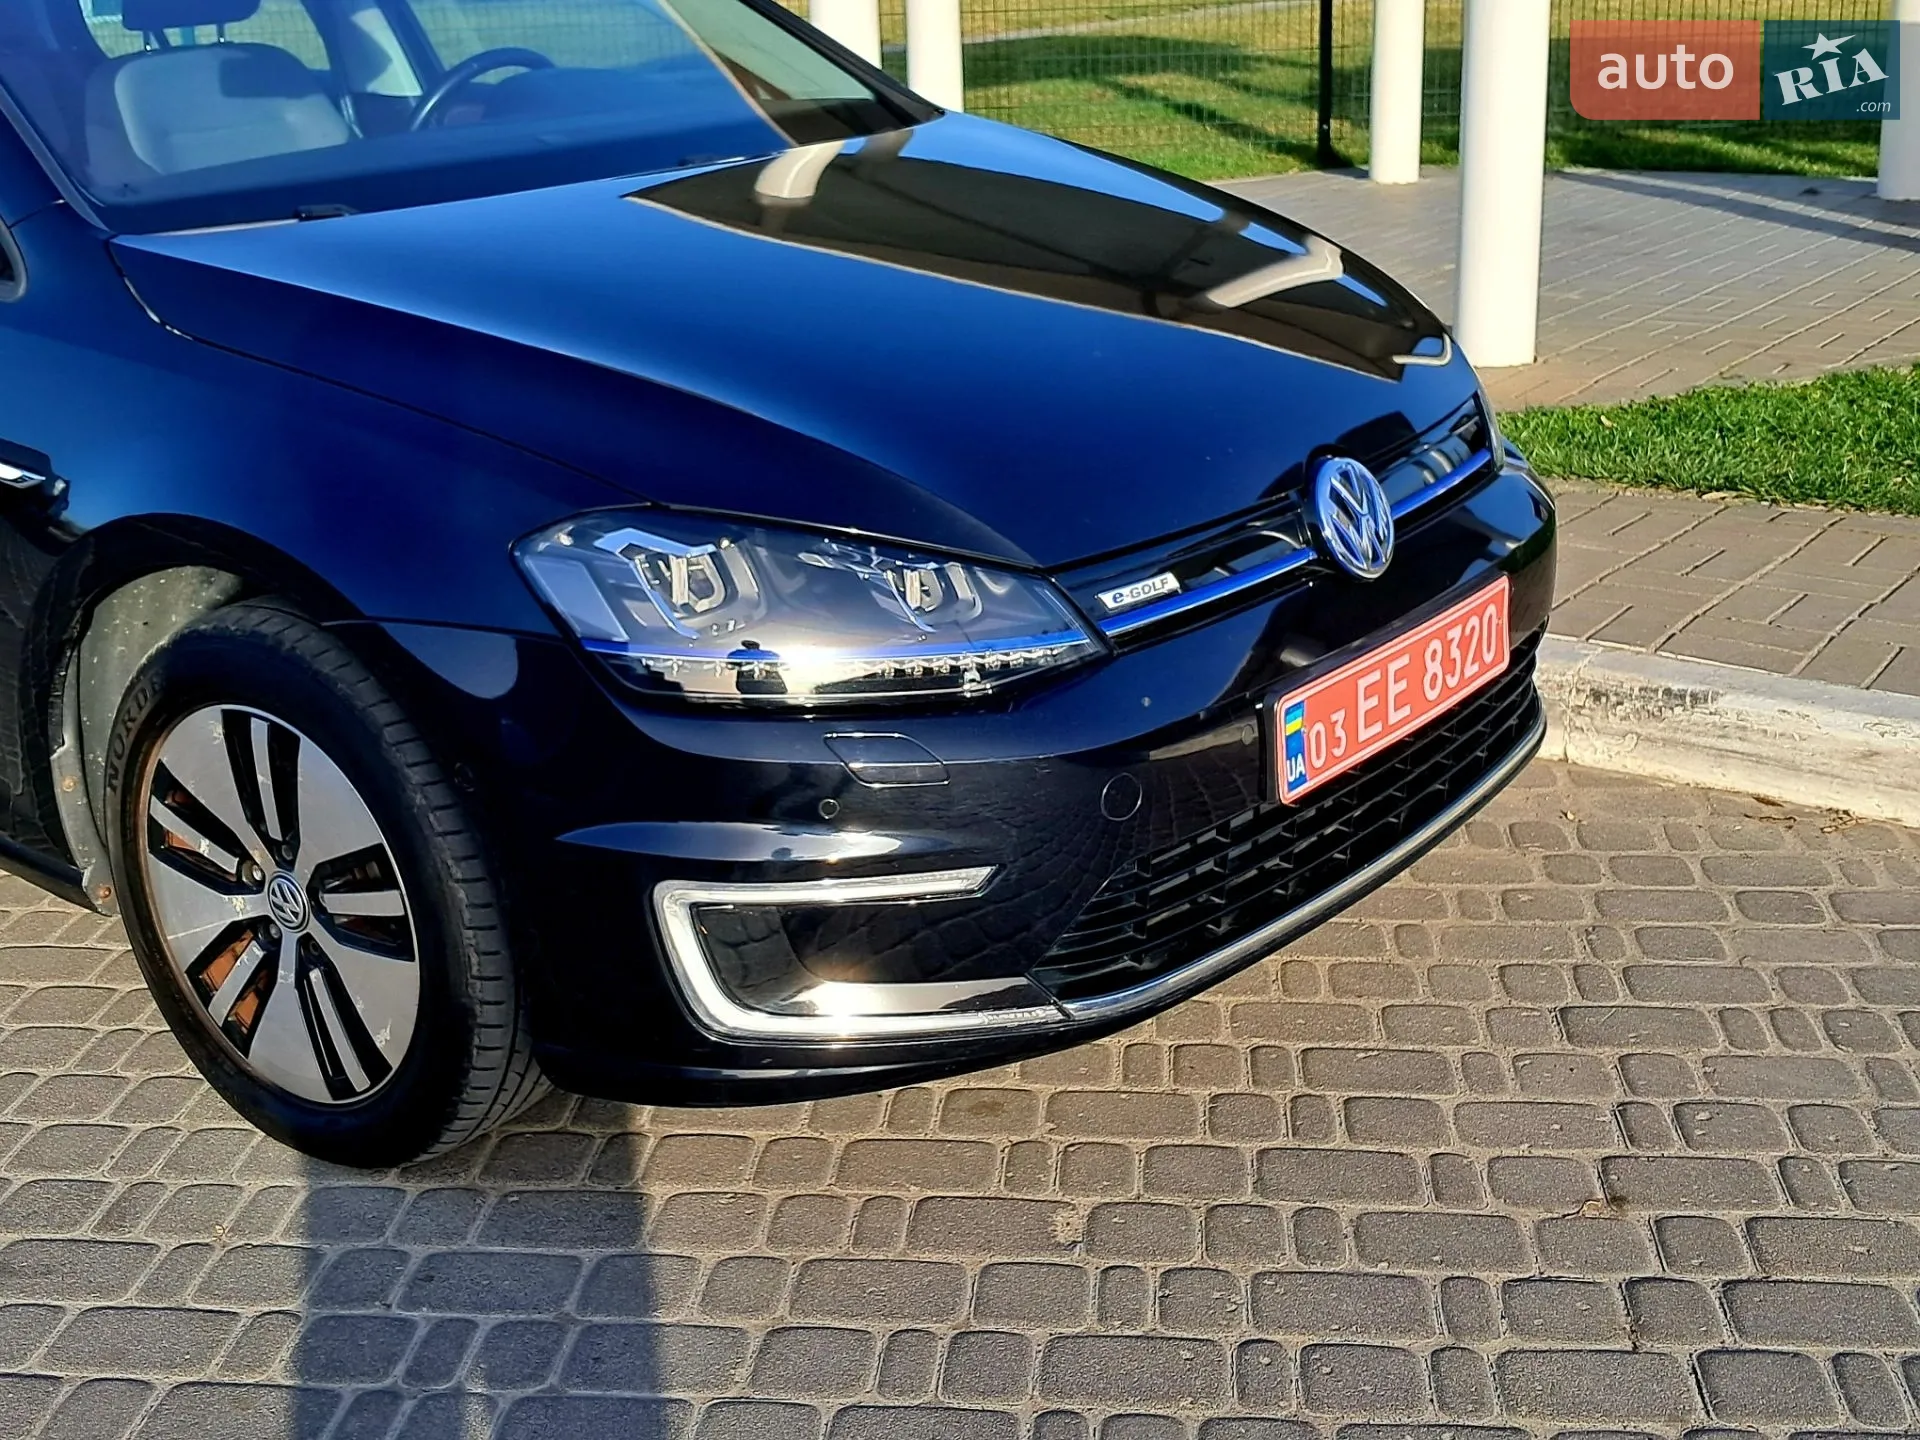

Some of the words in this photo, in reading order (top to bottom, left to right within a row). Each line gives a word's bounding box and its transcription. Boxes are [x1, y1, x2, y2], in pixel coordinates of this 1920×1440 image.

[1112, 577, 1169, 604] e-GOLF
[1309, 708, 1347, 769] 03
[1357, 653, 1411, 743] EE
[1423, 603, 1497, 701] 8320
[1286, 753, 1305, 782] UA
